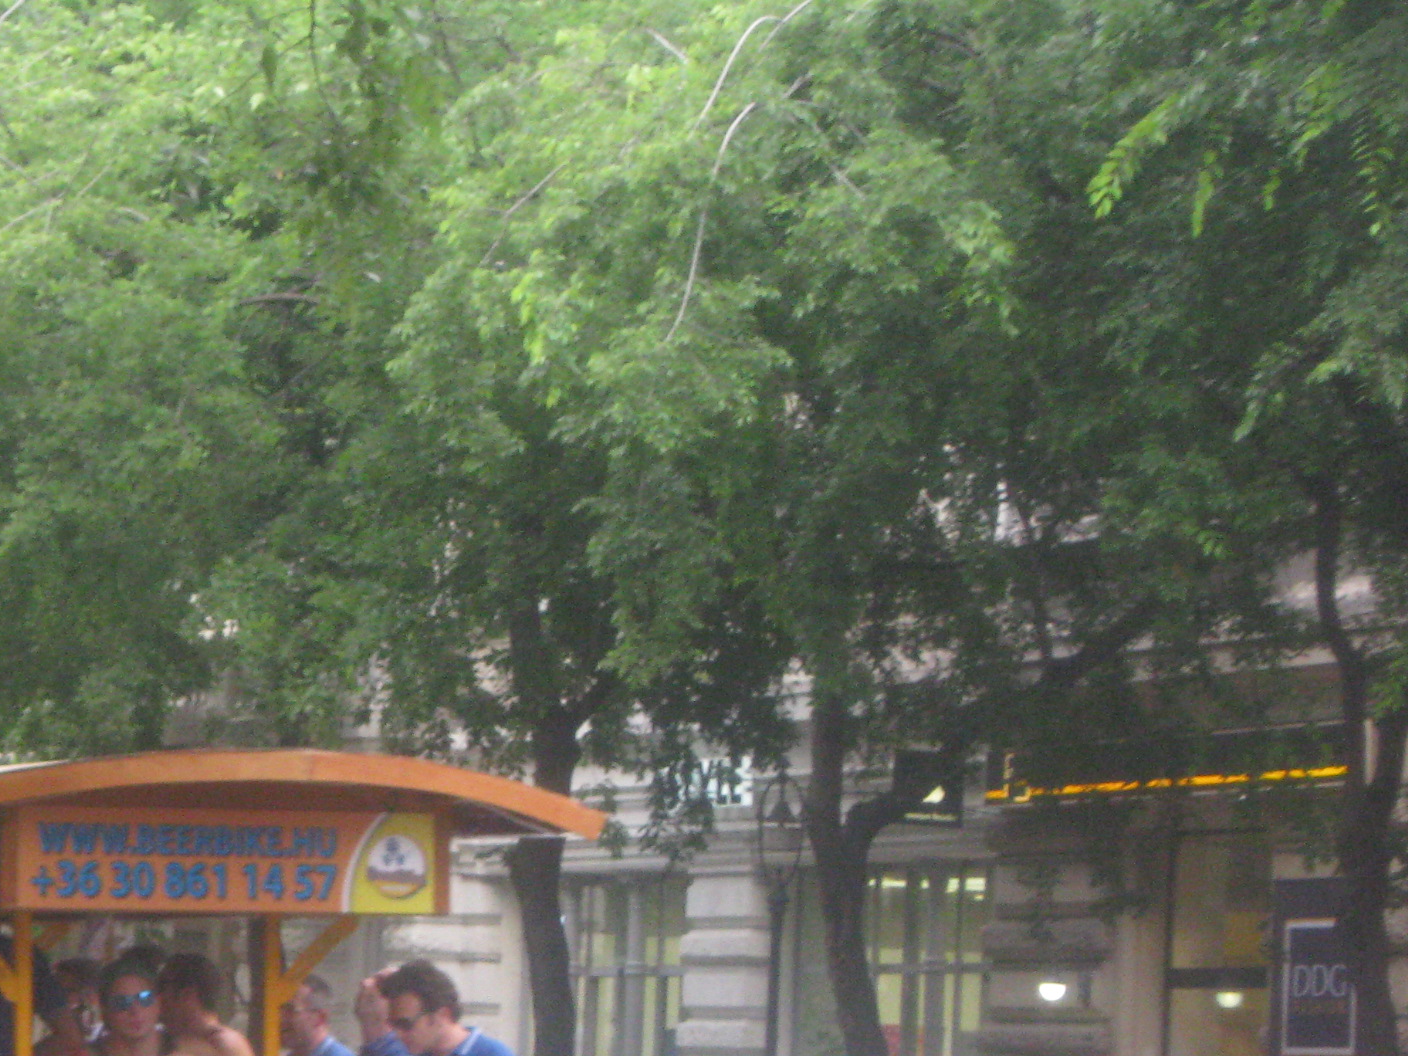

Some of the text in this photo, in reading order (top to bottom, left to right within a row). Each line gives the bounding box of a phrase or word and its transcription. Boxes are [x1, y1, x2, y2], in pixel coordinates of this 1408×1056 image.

[37, 822, 338, 857] WWW.BEERBIKE.HU
[32, 860, 101, 898] +36
[109, 861, 154, 898] 30
[164, 863, 228, 900] 861
[243, 865, 284, 901] 14
[295, 865, 338, 901] 57
